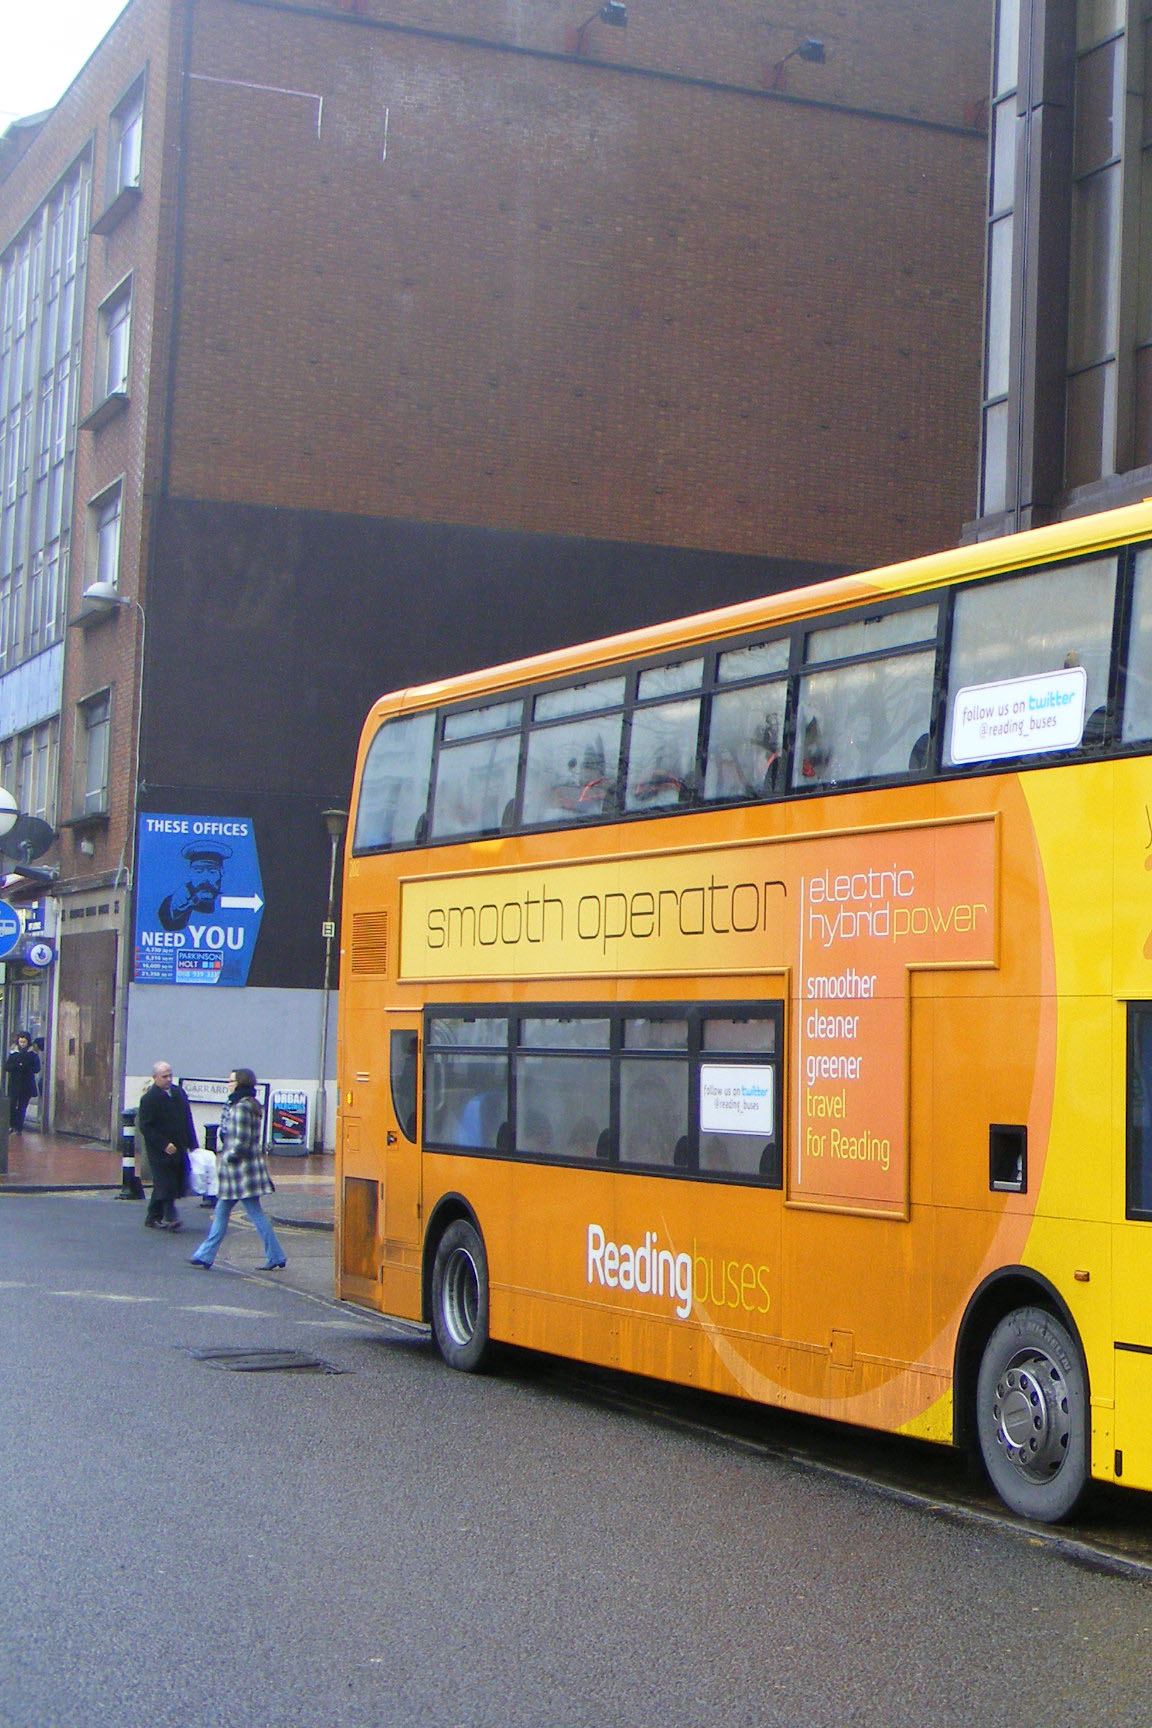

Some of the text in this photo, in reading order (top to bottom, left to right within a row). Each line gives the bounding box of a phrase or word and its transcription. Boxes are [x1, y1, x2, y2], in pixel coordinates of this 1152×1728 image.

[963, 689, 1076, 727] follow us on twitter
[146, 819, 248, 836] THESE OFFICES
[809, 863, 914, 903] electric
[427, 875, 787, 955] smooth operator
[142, 925, 244, 950] NEED YOU
[807, 968, 877, 998] smoother
[806, 1009, 859, 1038] cleaner
[806, 1055, 862, 1086] greener
[806, 1087, 846, 1118] travel
[806, 1127, 890, 1171] for Reading
